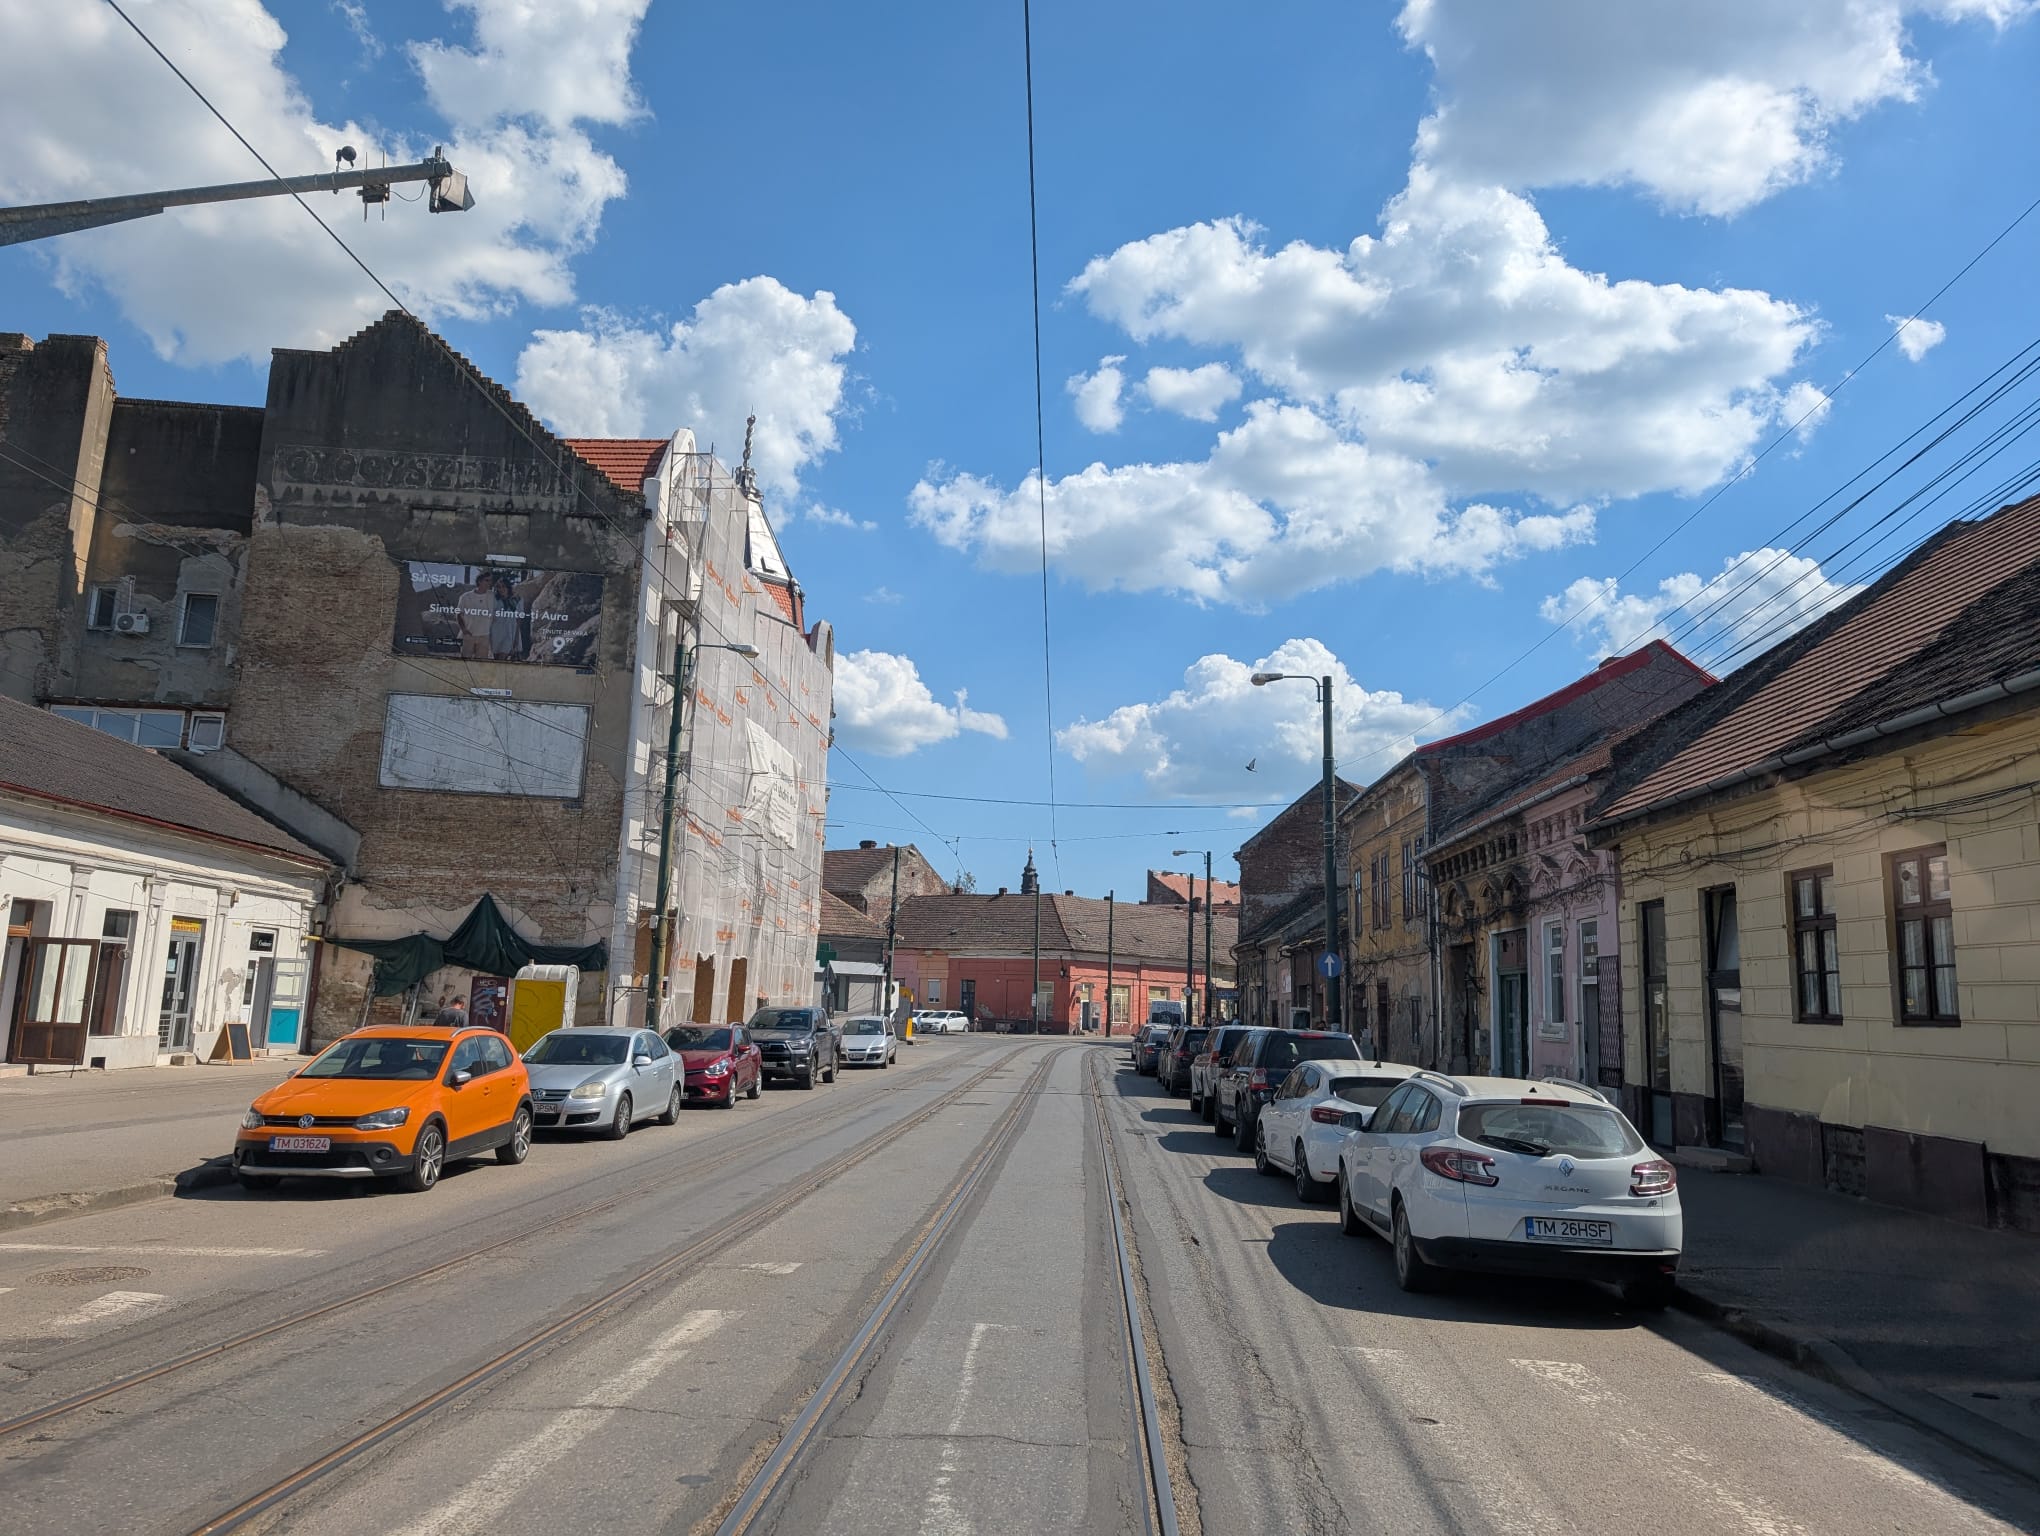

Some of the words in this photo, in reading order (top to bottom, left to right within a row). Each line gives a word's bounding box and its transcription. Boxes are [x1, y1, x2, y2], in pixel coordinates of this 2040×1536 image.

[411, 570, 456, 588] sinsay
[429, 603, 461, 614] Simte
[541, 611, 569, 621] Aura
[277, 1138, 291, 1149] TM
[293, 1138, 328, 1149] 031624
[1535, 1220, 1556, 1236] TM
[1560, 1222, 1608, 1238] 26HSF
